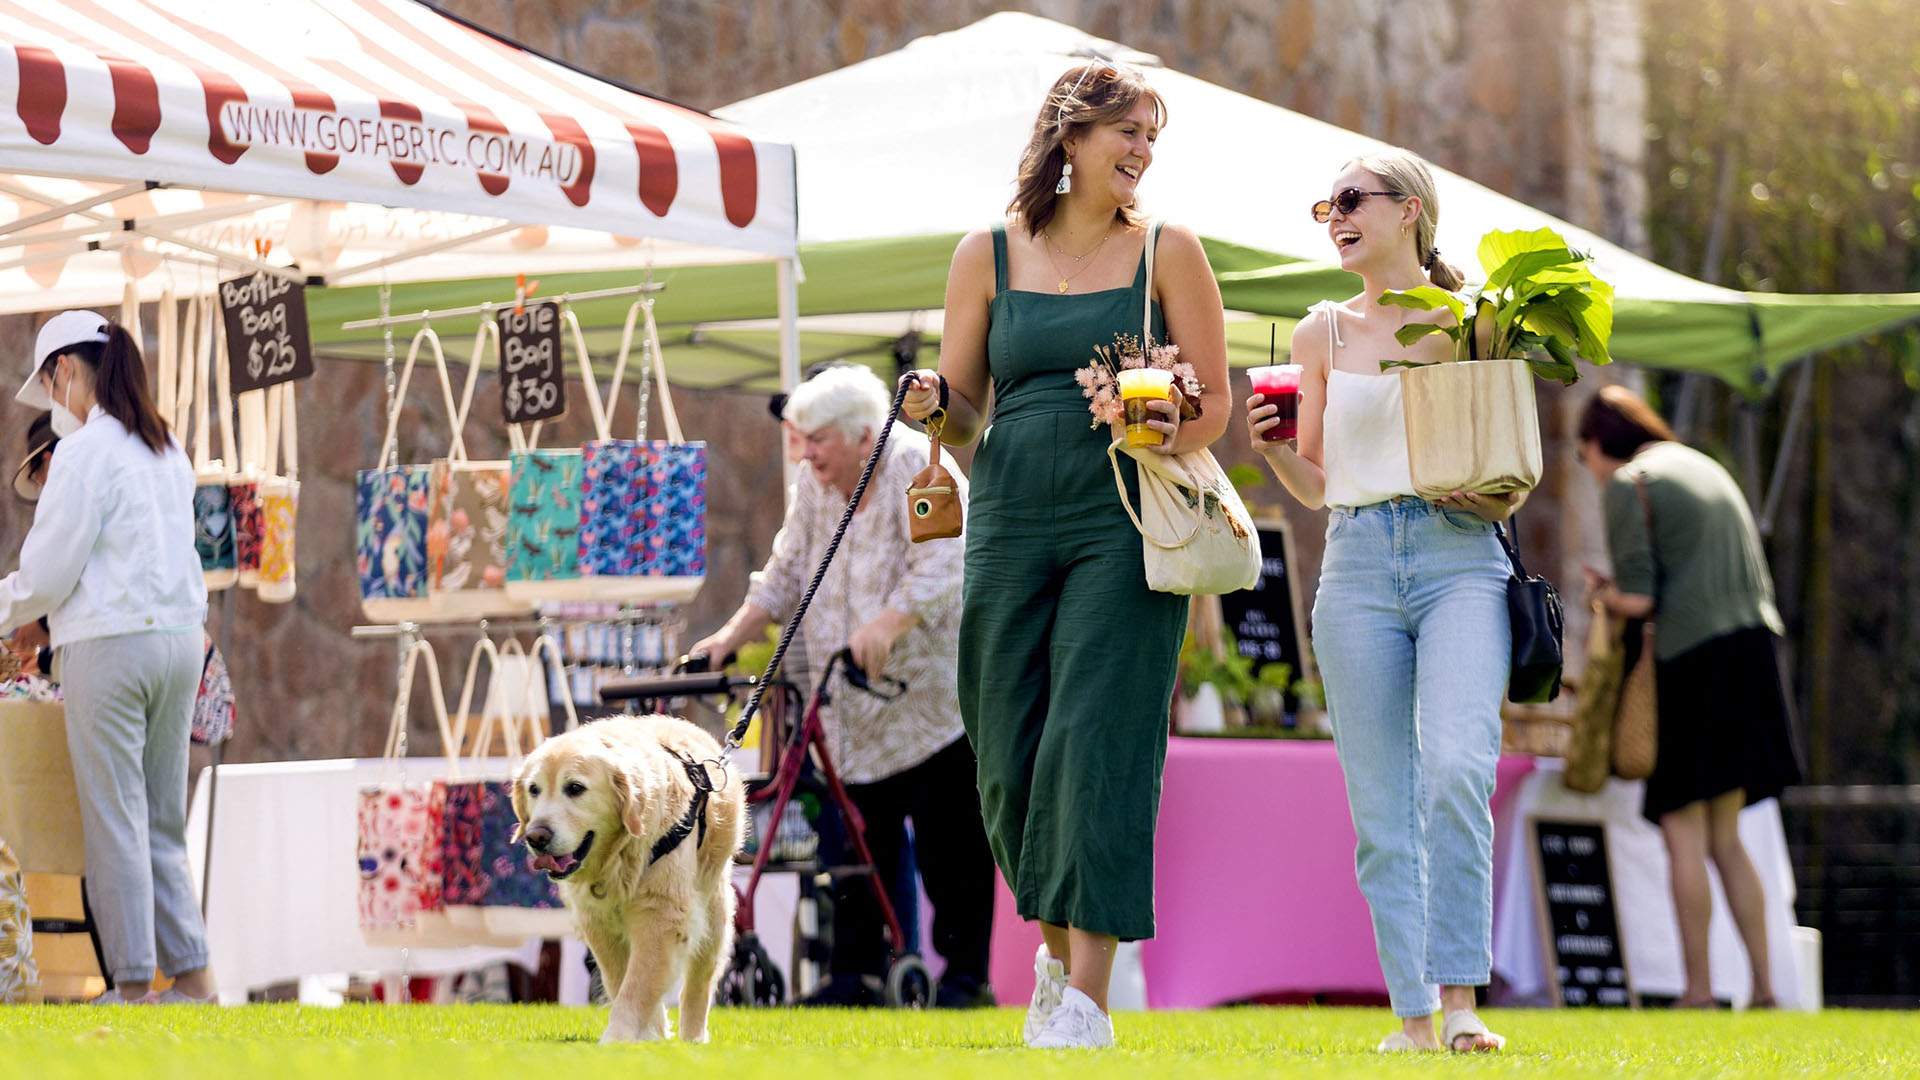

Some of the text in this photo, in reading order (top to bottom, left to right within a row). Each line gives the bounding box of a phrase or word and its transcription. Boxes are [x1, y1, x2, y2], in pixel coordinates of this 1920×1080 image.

[227, 103, 576, 182] WWW.GOFABRIC.COM.AU
[239, 305, 287, 338] Bag
[246, 335, 297, 381] $25
[505, 336, 553, 379] Bag
[505, 373, 558, 418] $30
